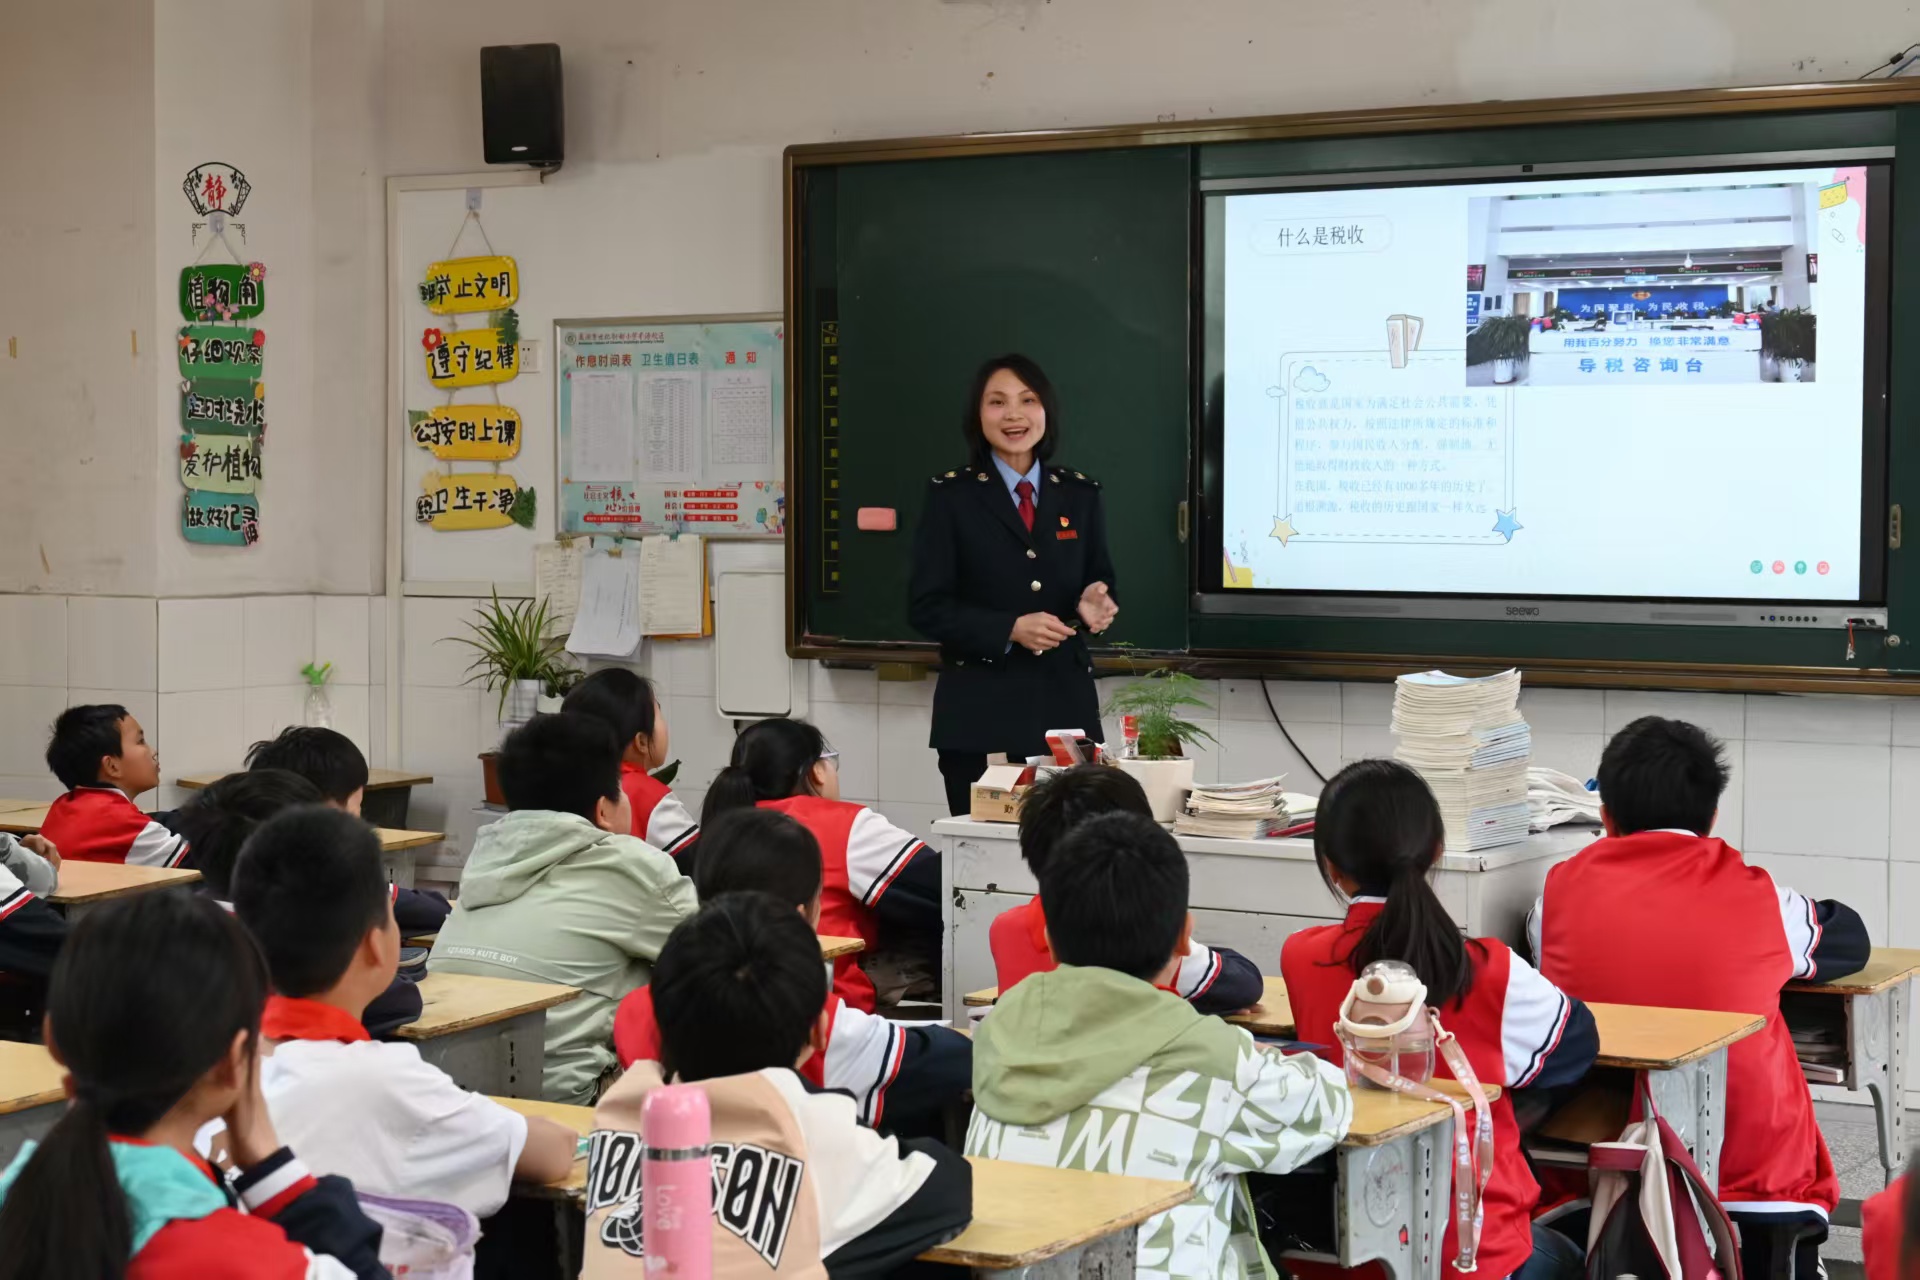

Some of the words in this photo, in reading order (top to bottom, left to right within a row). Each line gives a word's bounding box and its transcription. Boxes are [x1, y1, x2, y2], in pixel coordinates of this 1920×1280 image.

[201, 173, 227, 209] 静
[1277, 224, 1365, 248] 什么是税收
[188, 272, 257, 311] 植物角
[434, 272, 512, 304] 举止文明
[182, 339, 263, 364] 仔细观察
[1564, 337, 1637, 348] 用我百分努力
[428, 336, 515, 379] 遵守纪律
[575, 354, 632, 368] 作息时间表
[641, 352, 699, 367] 卫生值日表
[725, 351, 757, 364] 通知
[1578, 357, 1704, 373] 导税咨询台
[187, 393, 264, 425] 定时浇水
[425, 416, 517, 447] 按时上课
[184, 445, 262, 482] 爱护植物
[430, 486, 515, 514] 卫生干净
[187, 504, 258, 530] 做好记录
[1505, 606, 1540, 616] seewo
[476, 949, 500, 960] KUTE
[500, 953, 518, 964] BOY
